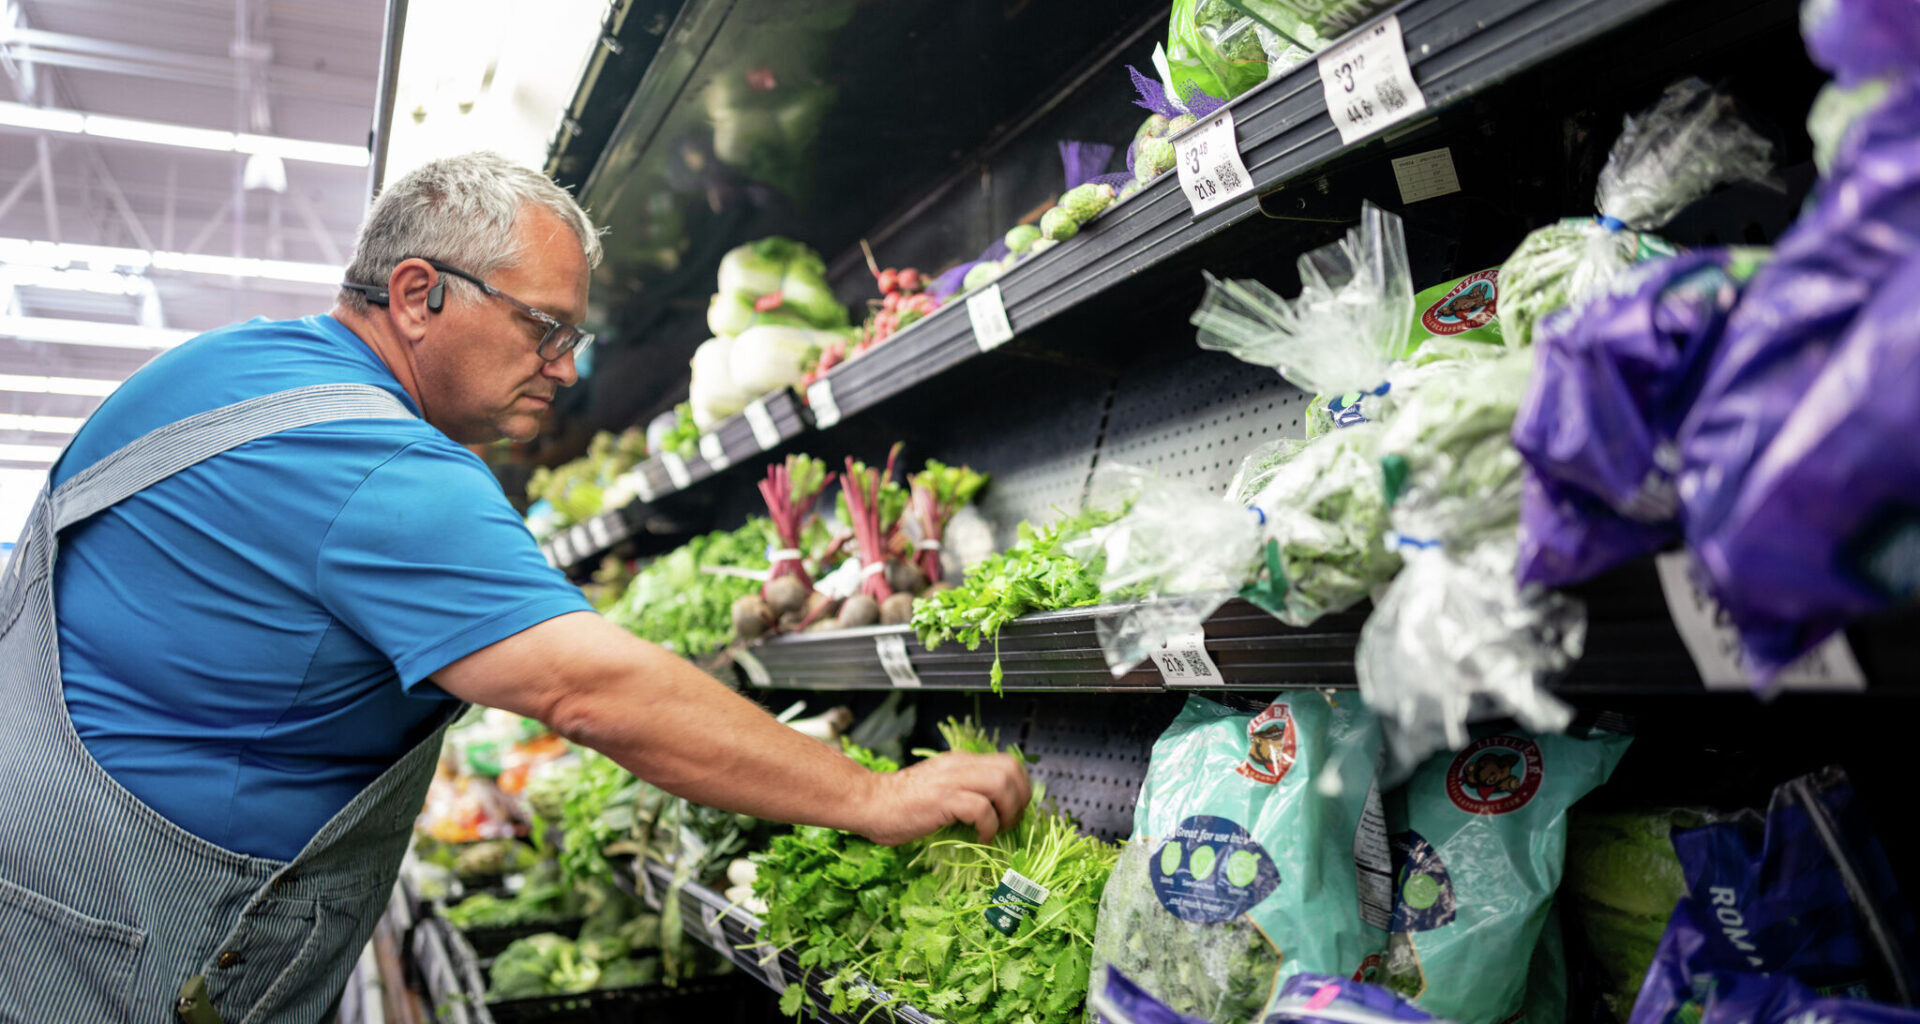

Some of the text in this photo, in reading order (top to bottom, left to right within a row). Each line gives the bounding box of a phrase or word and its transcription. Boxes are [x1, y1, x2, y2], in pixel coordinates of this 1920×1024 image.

[1176, 827, 1199, 840] Great
[1197, 828, 1214, 843] for
[1214, 833, 1230, 843] use
